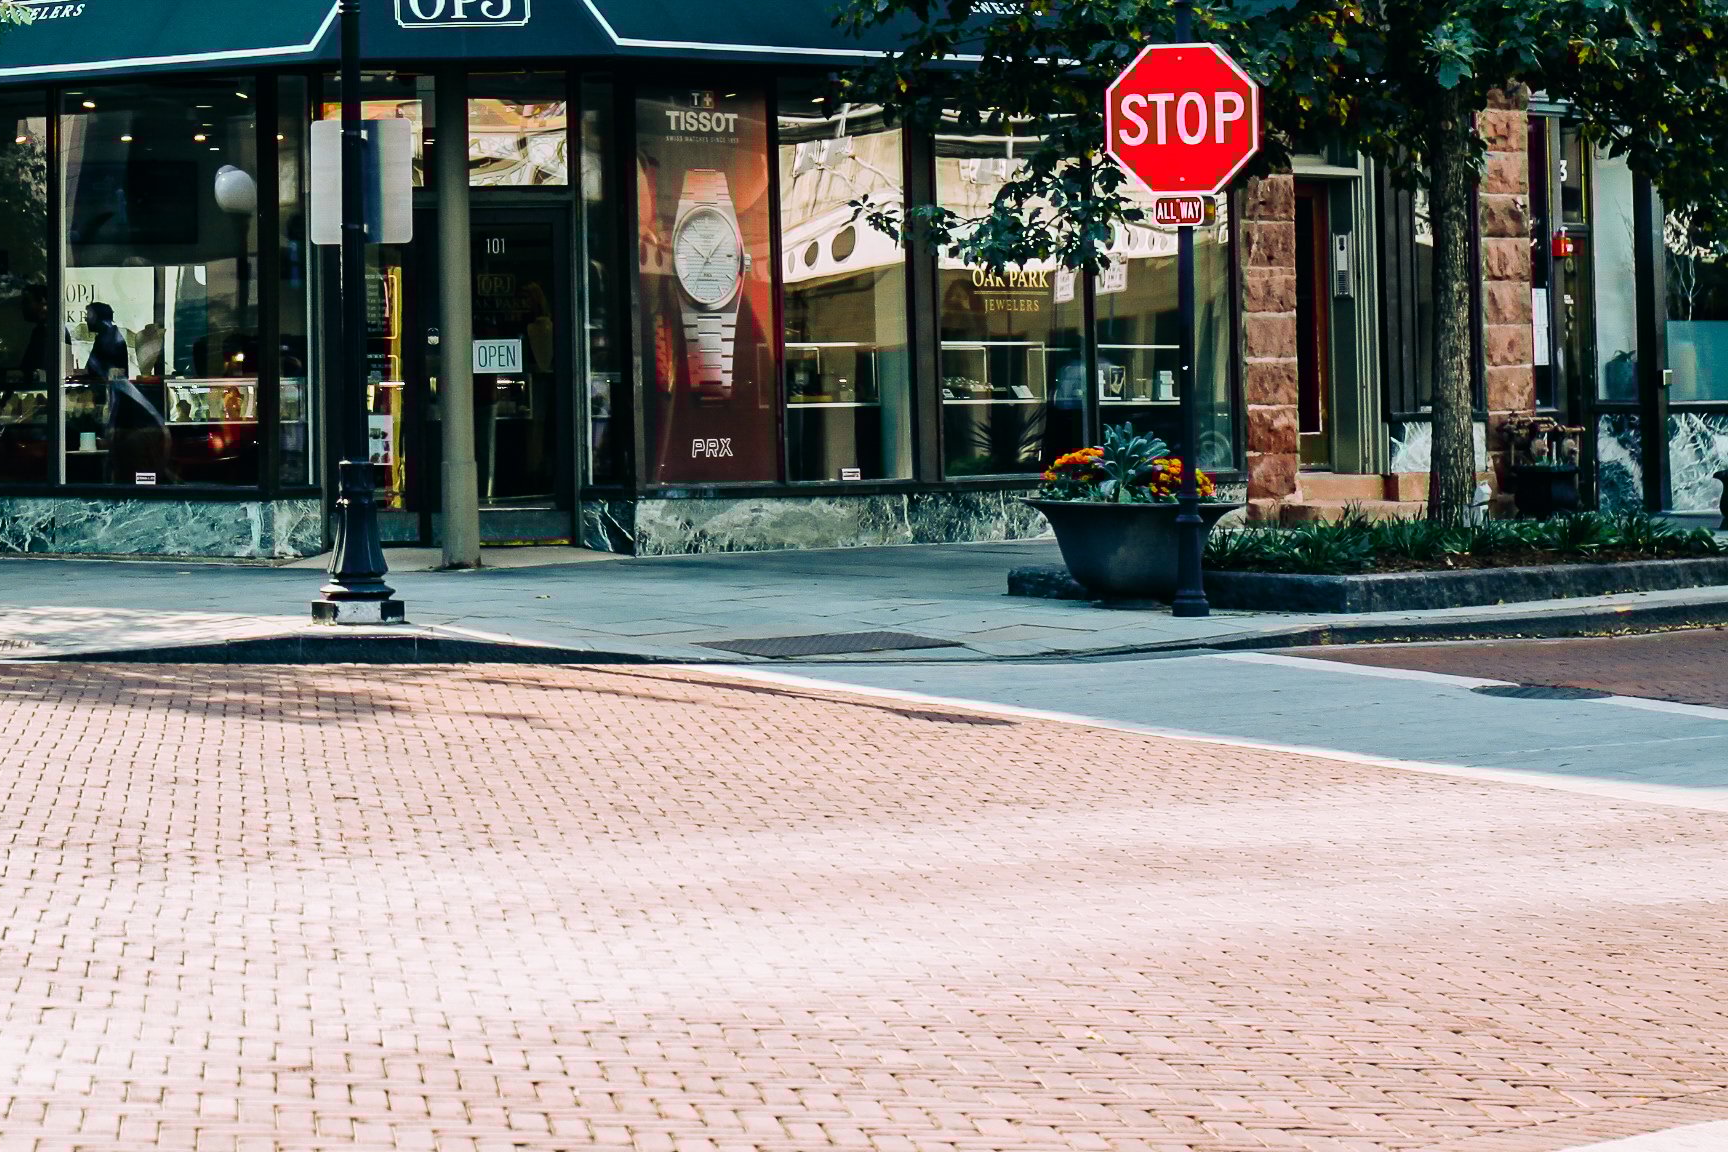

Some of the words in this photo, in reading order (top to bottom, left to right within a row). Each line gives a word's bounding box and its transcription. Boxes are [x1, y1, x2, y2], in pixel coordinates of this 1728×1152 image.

[665, 110, 739, 133] TISSOT
[1118, 91, 1245, 146] STOP
[1156, 202, 1177, 220] ALL
[1179, 201, 1201, 219] WAY
[485, 237, 505, 254] 101
[481, 276, 512, 293] OPJ
[1009, 269, 1049, 288] PARK
[66, 284, 95, 303] OPJ
[983, 299, 1040, 313] JEWELERS
[478, 345, 516, 367] OPEN
[691, 438, 733, 458] PRX
